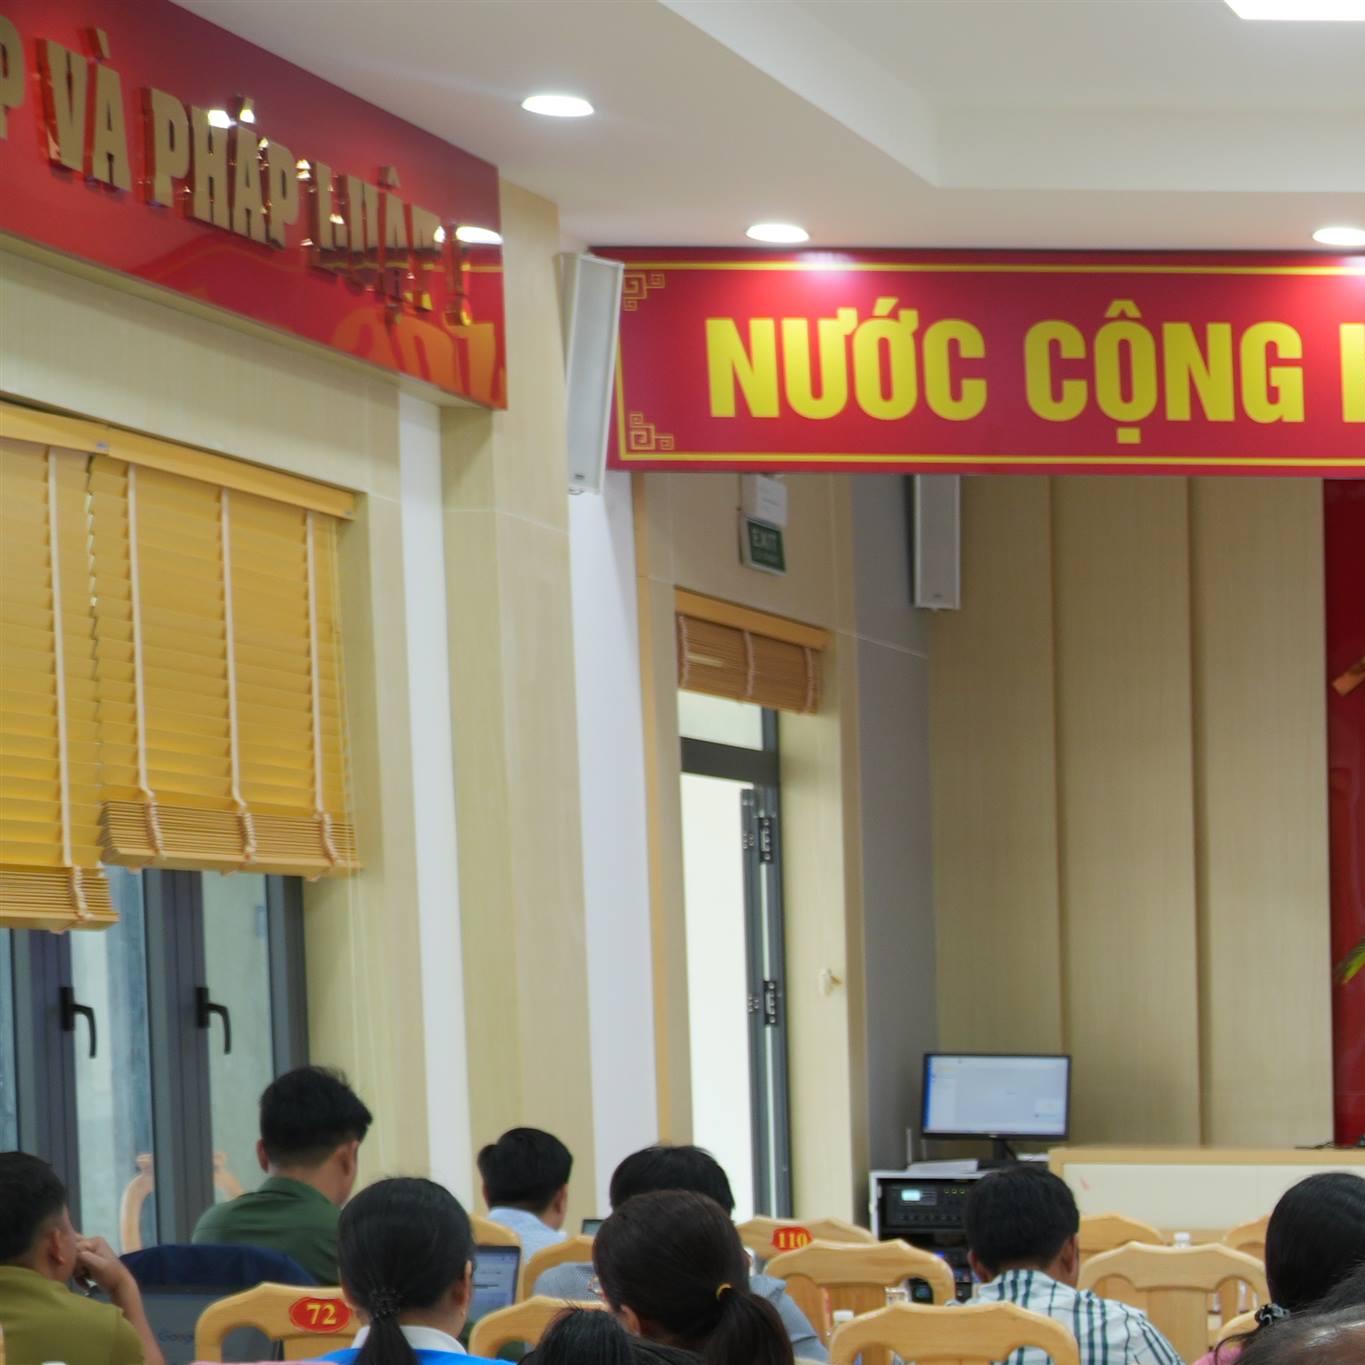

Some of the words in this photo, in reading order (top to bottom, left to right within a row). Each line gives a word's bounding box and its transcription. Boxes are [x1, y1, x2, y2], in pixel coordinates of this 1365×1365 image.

[41, 28, 131, 193] VÀ
[147, 87, 300, 250] PHÁP
[706, 297, 987, 421] NƯỚC
[1026, 300, 1305, 443] CỘNG
[307, 1303, 337, 1325] 72
